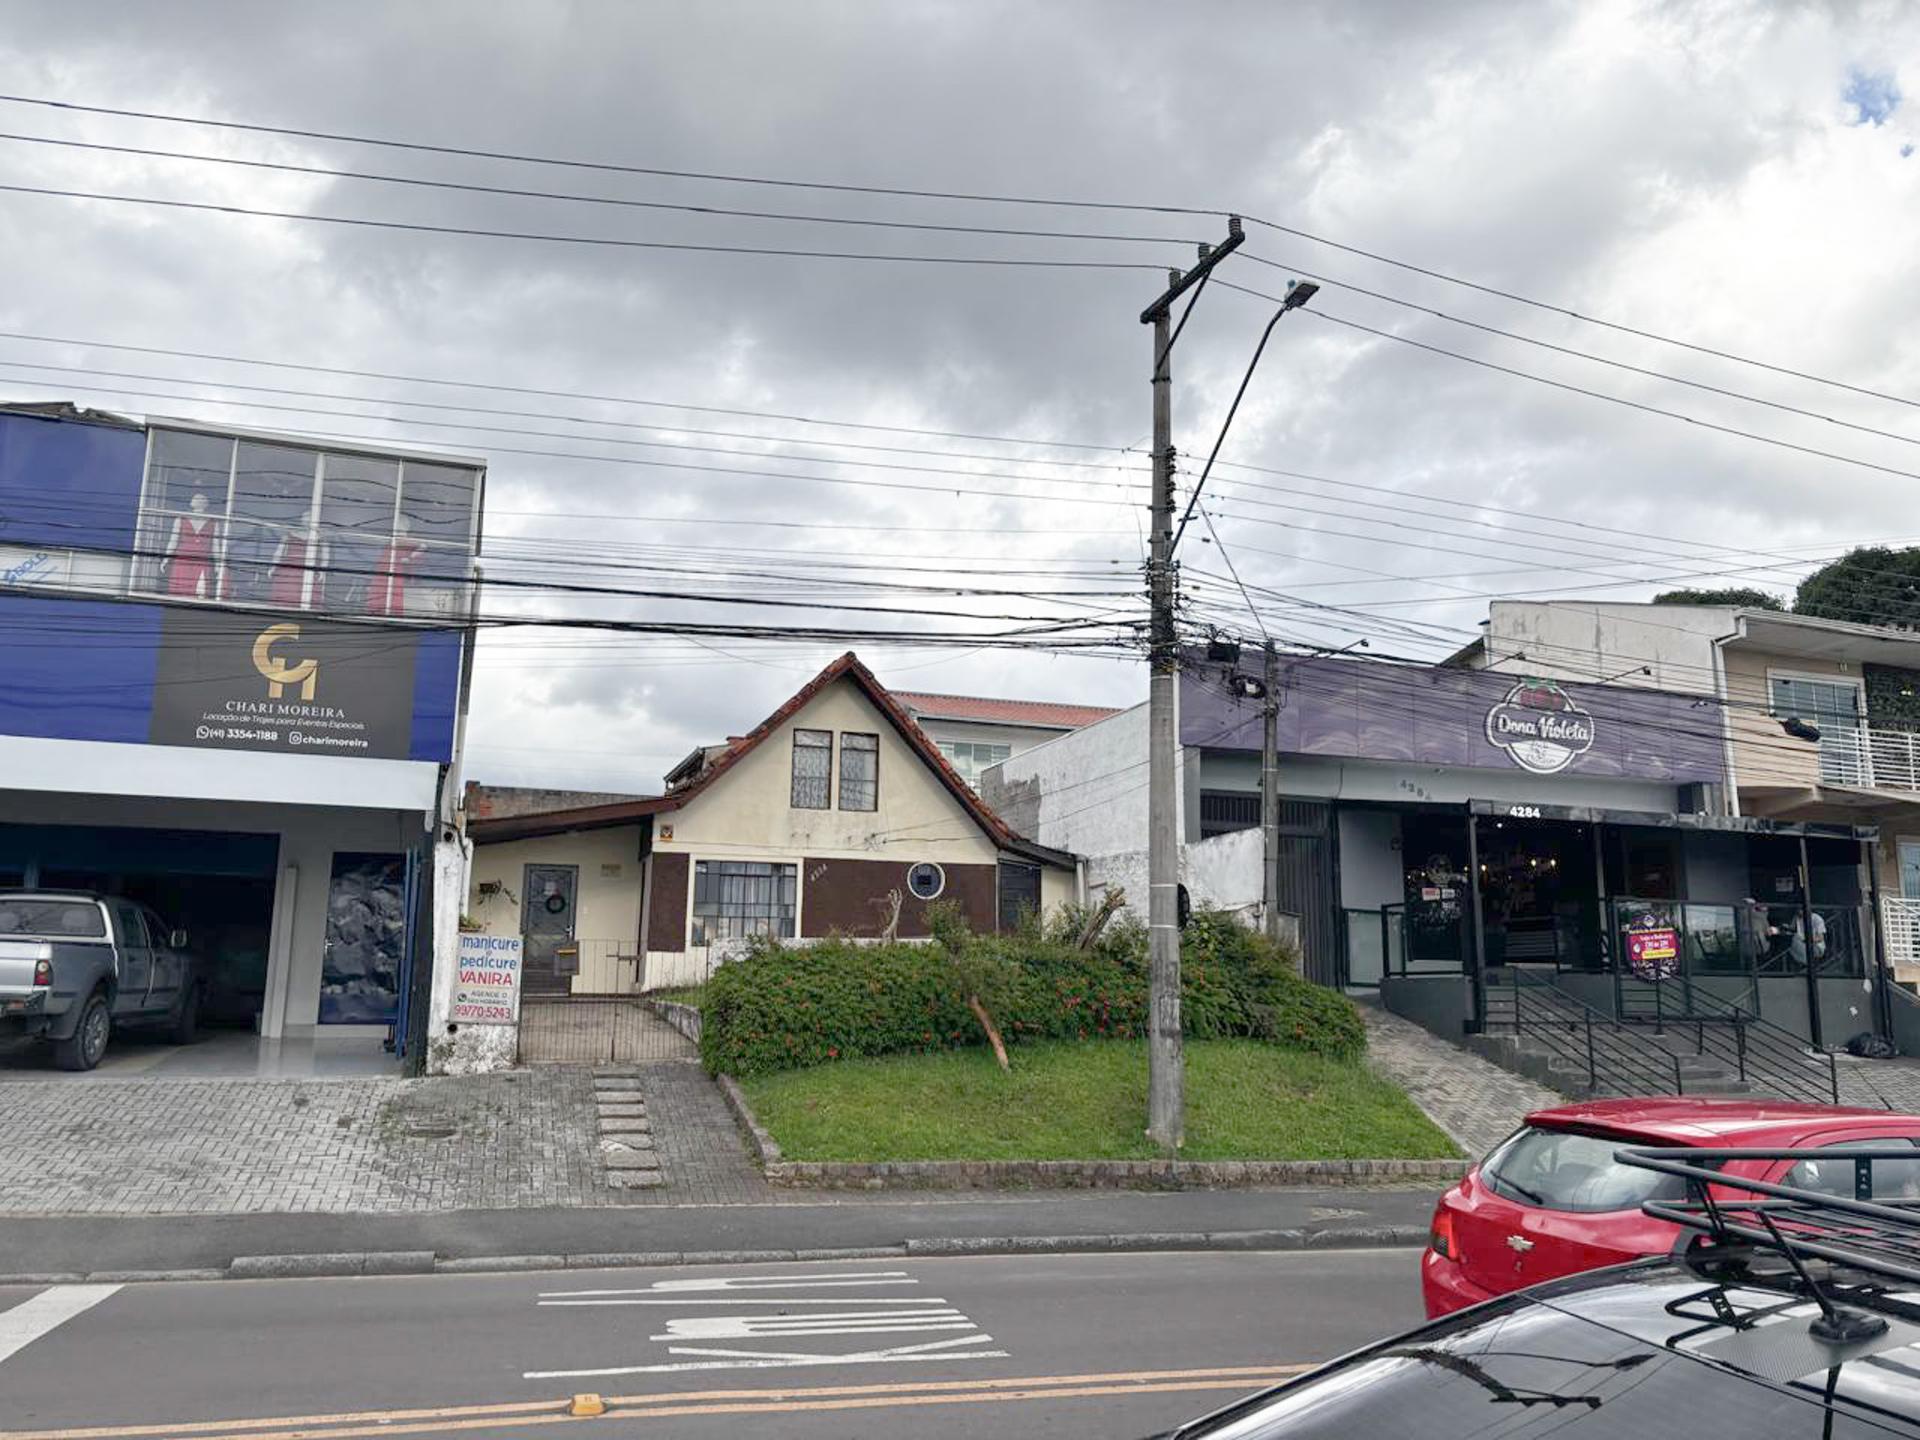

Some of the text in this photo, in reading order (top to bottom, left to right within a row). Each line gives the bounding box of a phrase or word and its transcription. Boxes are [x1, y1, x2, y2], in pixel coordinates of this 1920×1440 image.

[225, 700, 345, 719] CHARI MOREIRA
[240, 714, 251, 722] de
[276, 718, 296, 726] para
[1498, 714, 1589, 741] Dona Violeta
[227, 727, 278, 741] 3354-1188
[302, 735, 369, 748] charimoreira
[1509, 806, 1541, 819] 4284
[462, 935, 519, 951] manicure
[459, 956, 517, 970] pedicure
[459, 970, 513, 986] VANIRA
[454, 1004, 512, 1020] 99770-5243
